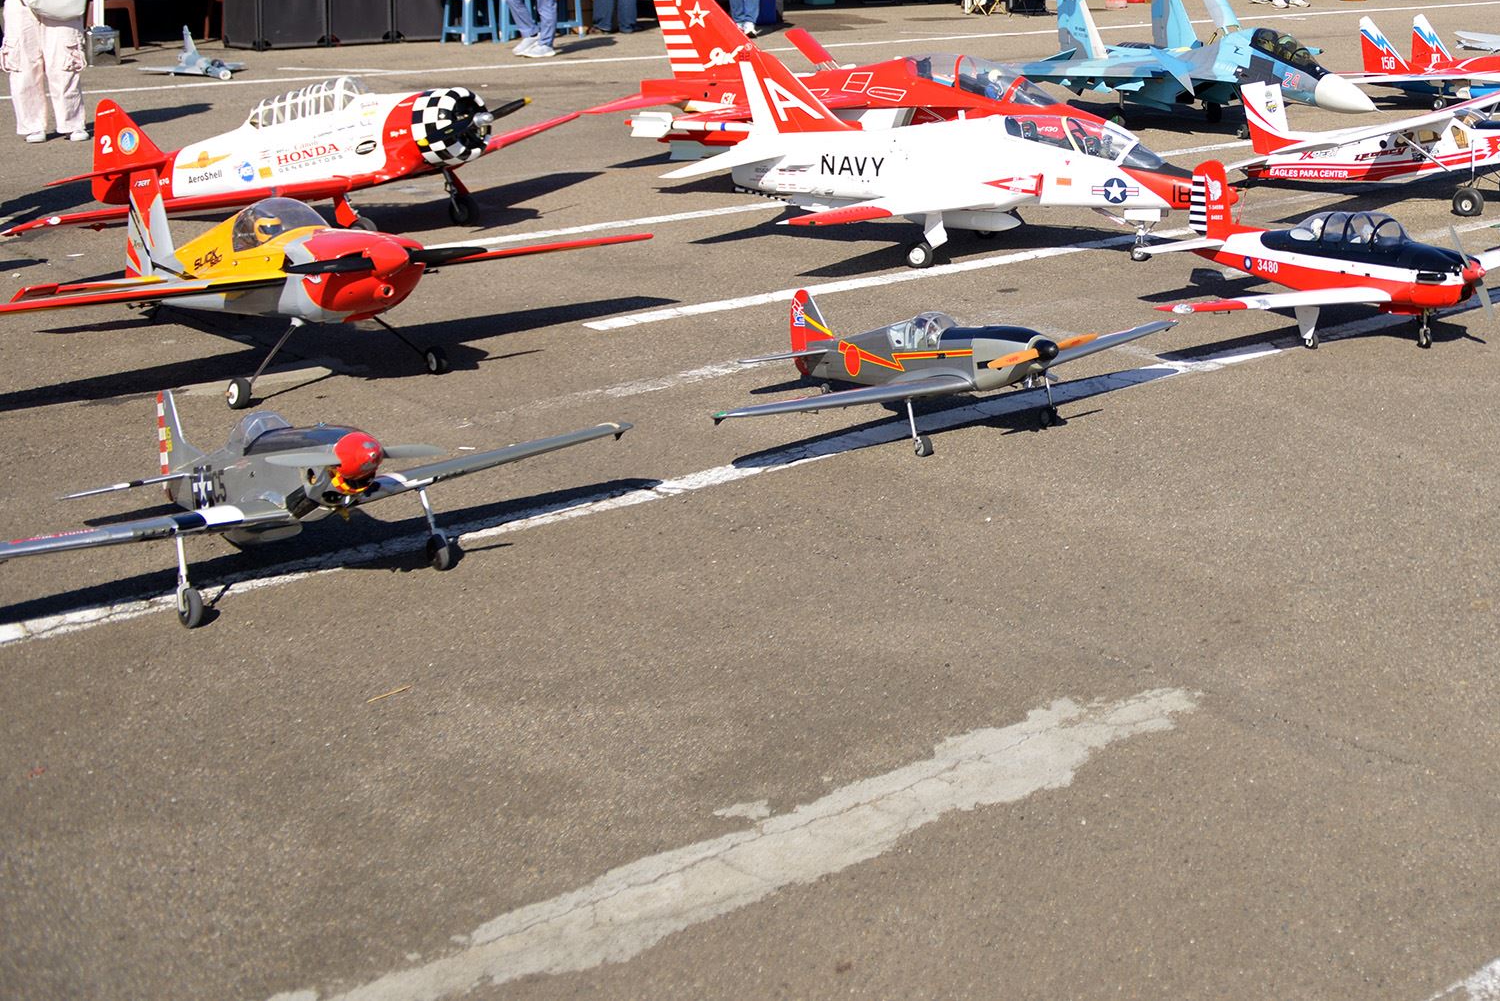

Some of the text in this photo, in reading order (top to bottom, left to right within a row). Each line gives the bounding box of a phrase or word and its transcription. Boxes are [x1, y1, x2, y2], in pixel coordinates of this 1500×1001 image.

[1381, 56, 1396, 70] 156
[763, 77, 825, 122] A
[100, 135, 113, 154] 2
[276, 143, 340, 166] HONDA
[821, 155, 885, 177] NAVY
[1269, 167, 1349, 179] EAGLES PARA CENTER
[188, 169, 223, 184] AeroShell
[1257, 259, 1279, 274] 3480
